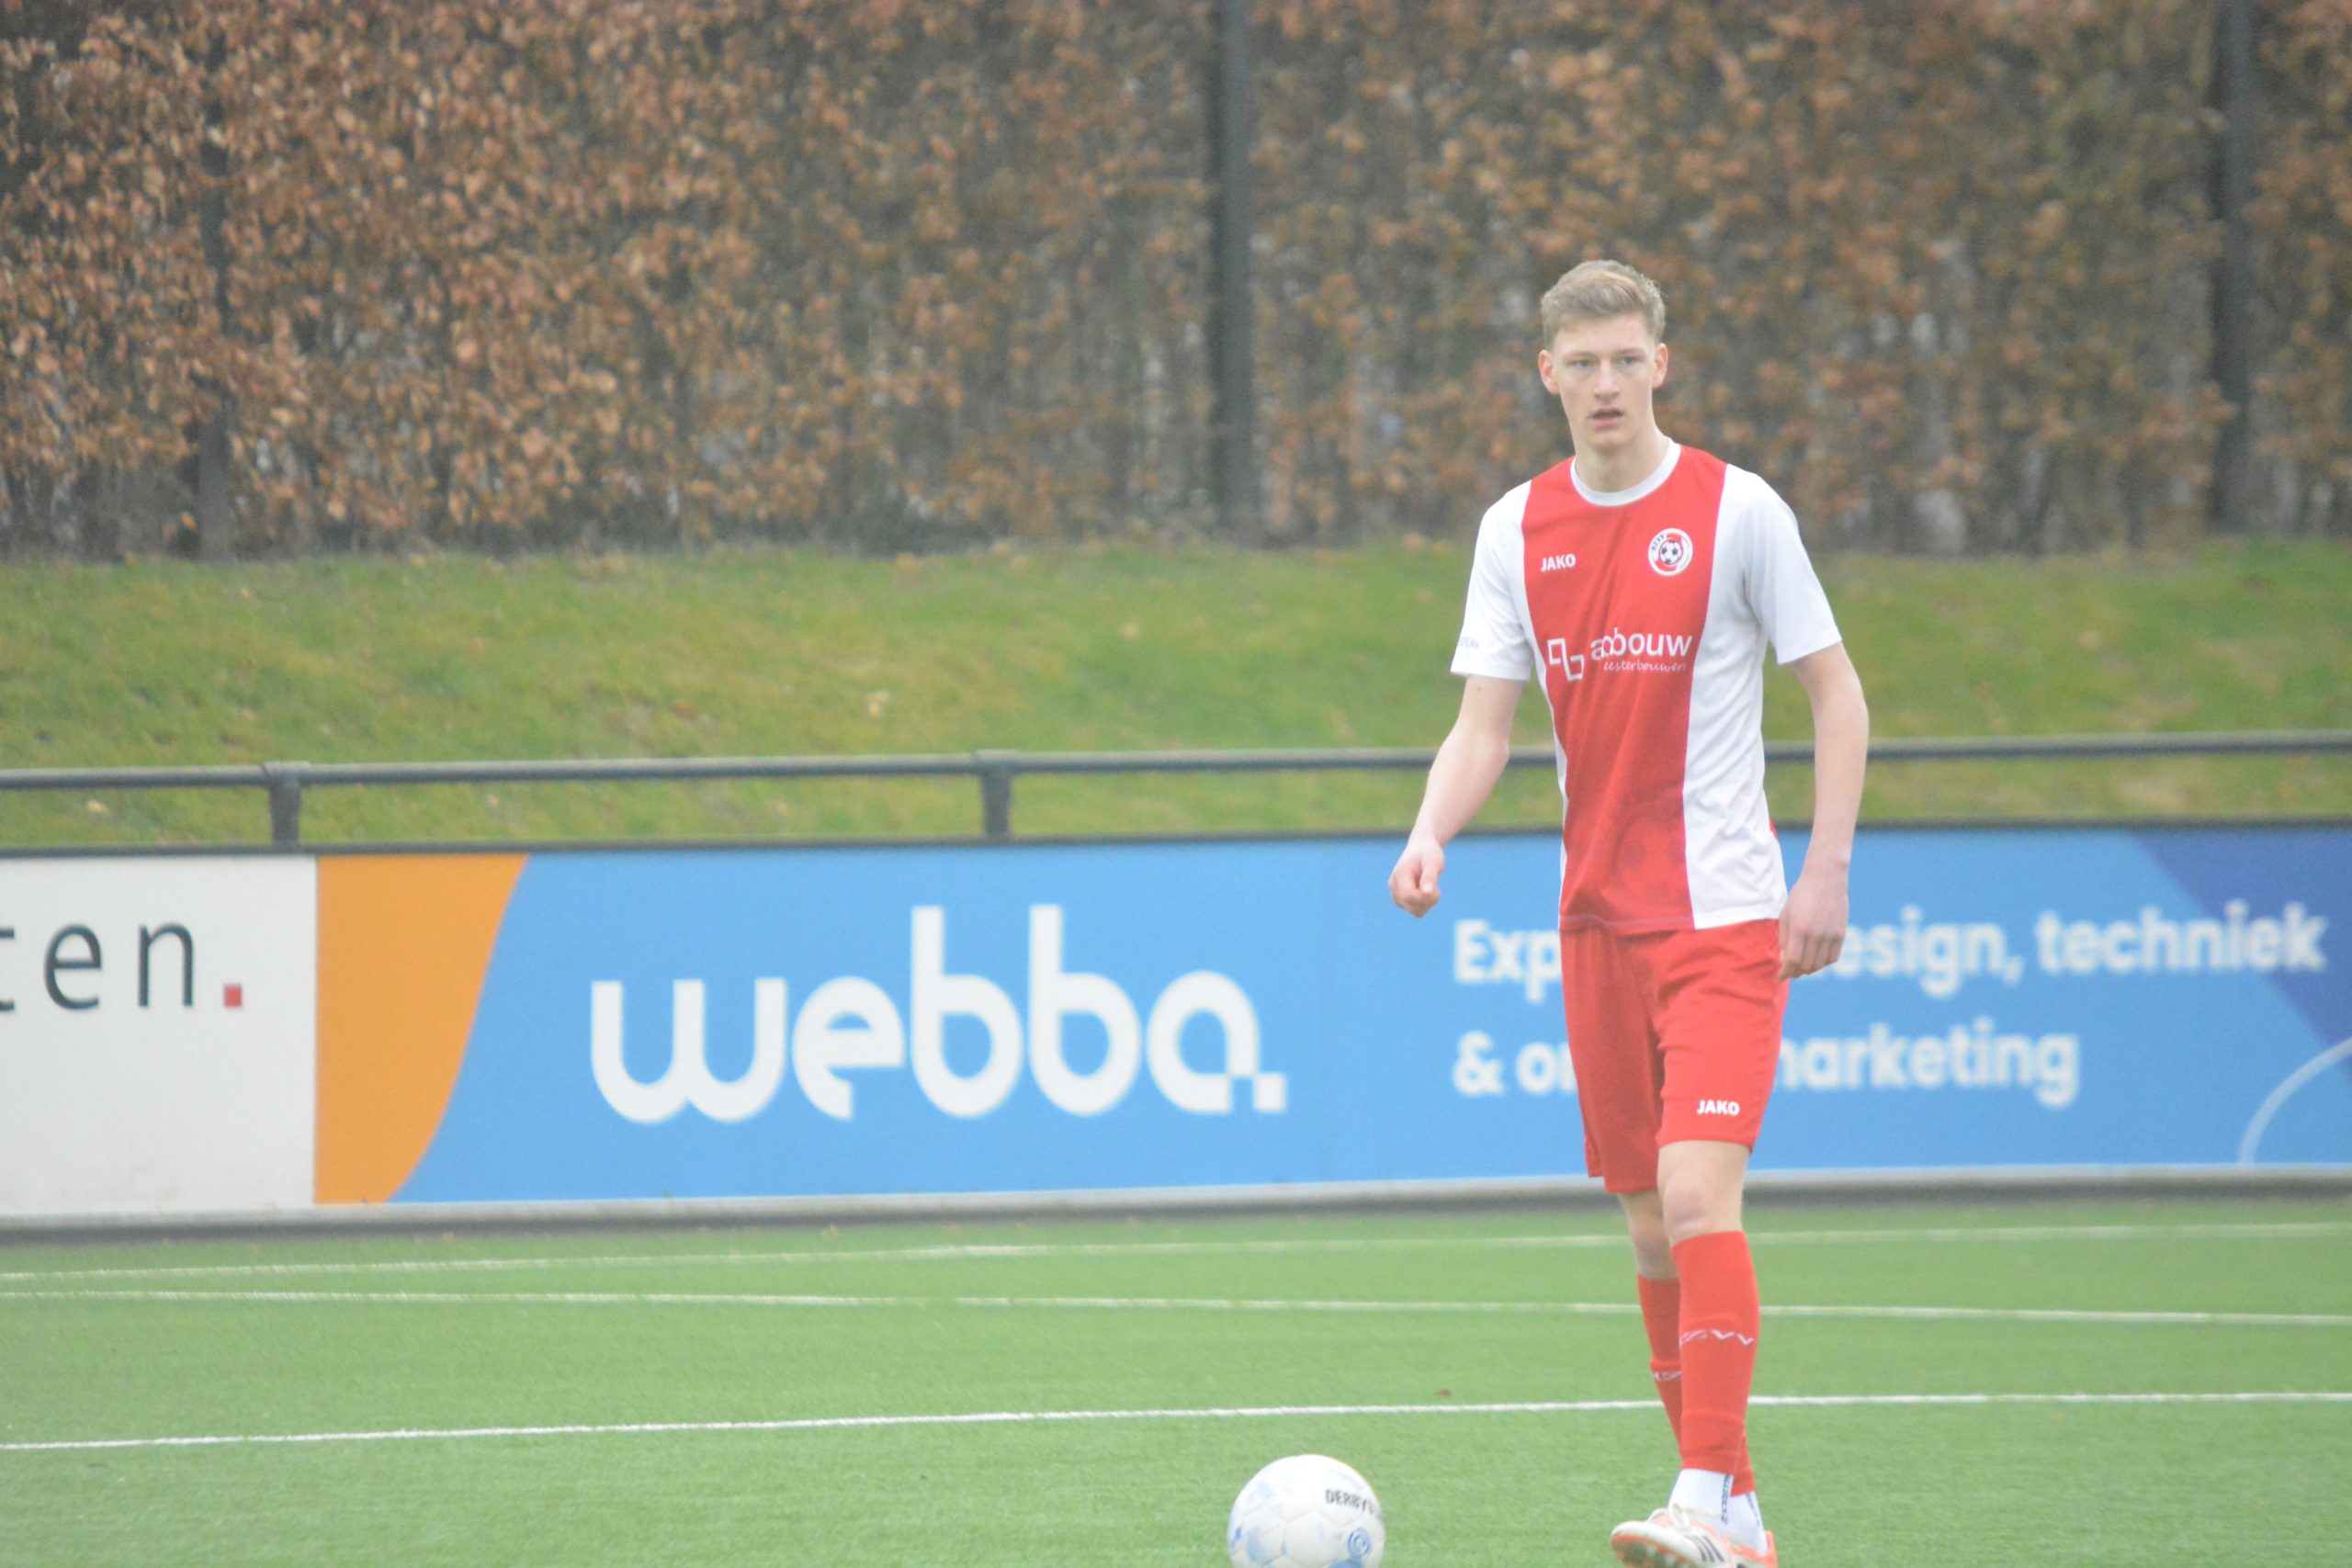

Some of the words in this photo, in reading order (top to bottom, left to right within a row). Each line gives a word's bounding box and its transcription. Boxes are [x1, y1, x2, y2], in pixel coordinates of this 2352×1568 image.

[1541, 553, 1577, 572] JAKO
[1454, 919, 1561, 1003] Exp
[1816, 904, 2022, 998] esign,
[2033, 898, 2326, 972] techniek
[1454, 1031, 1503, 1095] &
[1696, 1100, 1740, 1116] JAKO
